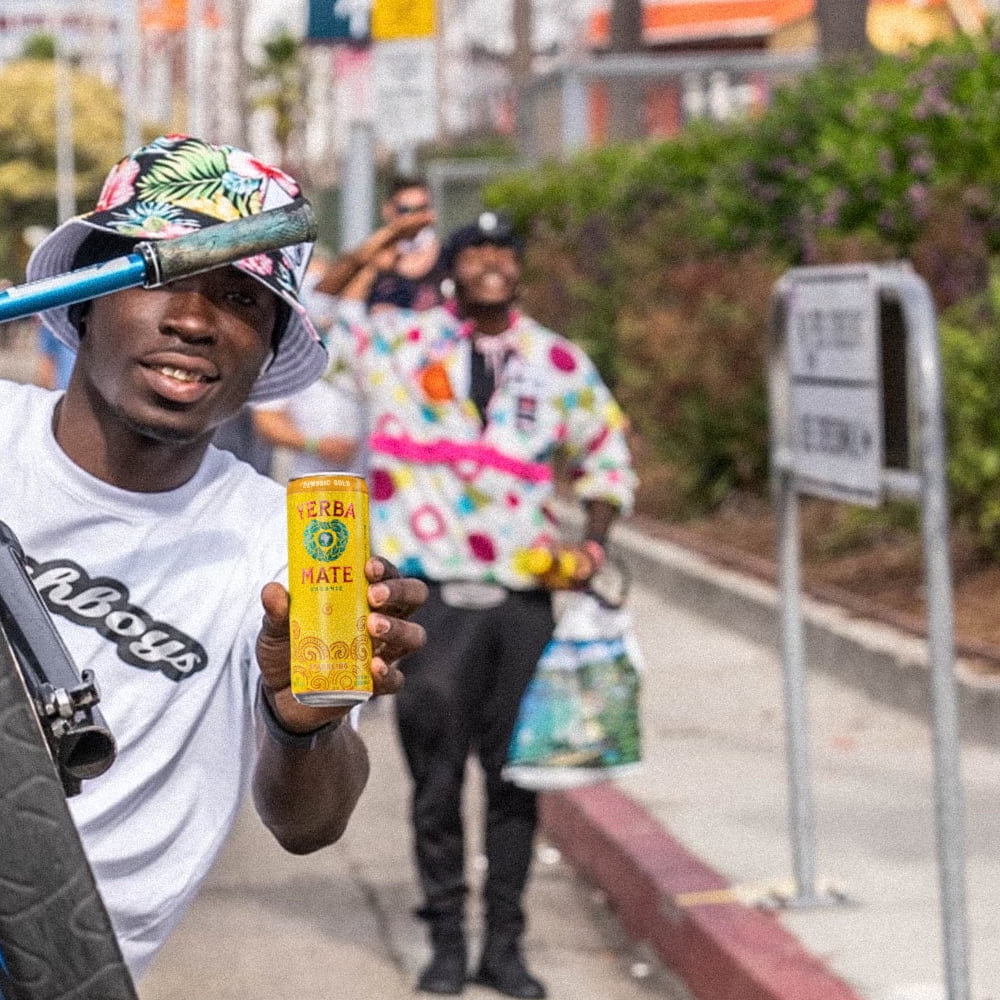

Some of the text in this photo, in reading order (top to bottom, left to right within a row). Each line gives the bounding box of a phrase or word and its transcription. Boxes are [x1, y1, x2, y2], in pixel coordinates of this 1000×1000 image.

[296, 500, 356, 520] YERBA
[301, 565, 354, 584] MATE
[24, 560, 205, 677] hboys
